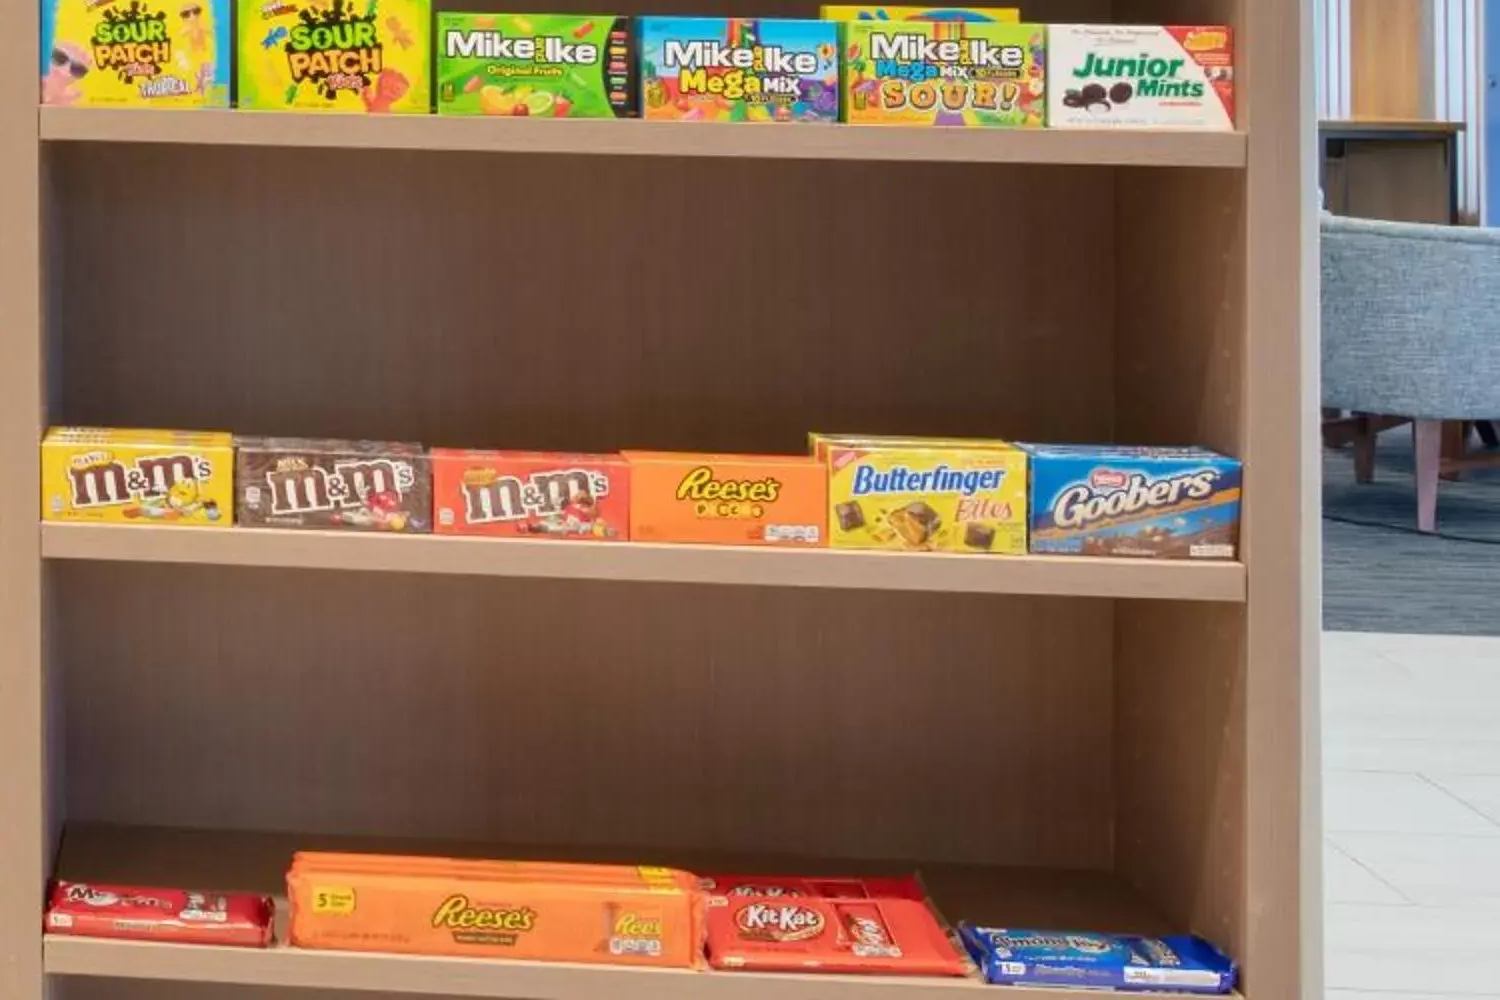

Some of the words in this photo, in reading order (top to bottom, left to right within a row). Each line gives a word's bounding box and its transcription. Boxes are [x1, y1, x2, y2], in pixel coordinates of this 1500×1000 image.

[95, 21, 166, 43] SOUR
[291, 23, 377, 51] SOUR
[94, 42, 171, 65] PATCH
[288, 49, 383, 75] PATCH
[446, 31, 535, 59] Mike
[545, 38, 597, 65] Ike
[664, 40, 753, 68] Mike
[764, 47, 817, 74] Ike
[870, 33, 960, 63] Mike
[972, 39, 1023, 68] Ike
[487, 64, 531, 77] Original
[533, 66, 563, 77] Fruits
[875, 60, 938, 83] Mega
[1072, 52, 1185, 79] Junior
[680, 68, 762, 99] Mega
[762, 76, 801, 94] Mix
[883, 80, 1019, 112] SOUR!
[1136, 80, 1205, 98] Mints
[676, 467, 781, 502] Reese's
[854, 466, 1006, 496] Butterfinger
[1053, 470, 1220, 529] Goobers
[317, 892, 328, 908] 5
[432, 893, 537, 930] Reese's
